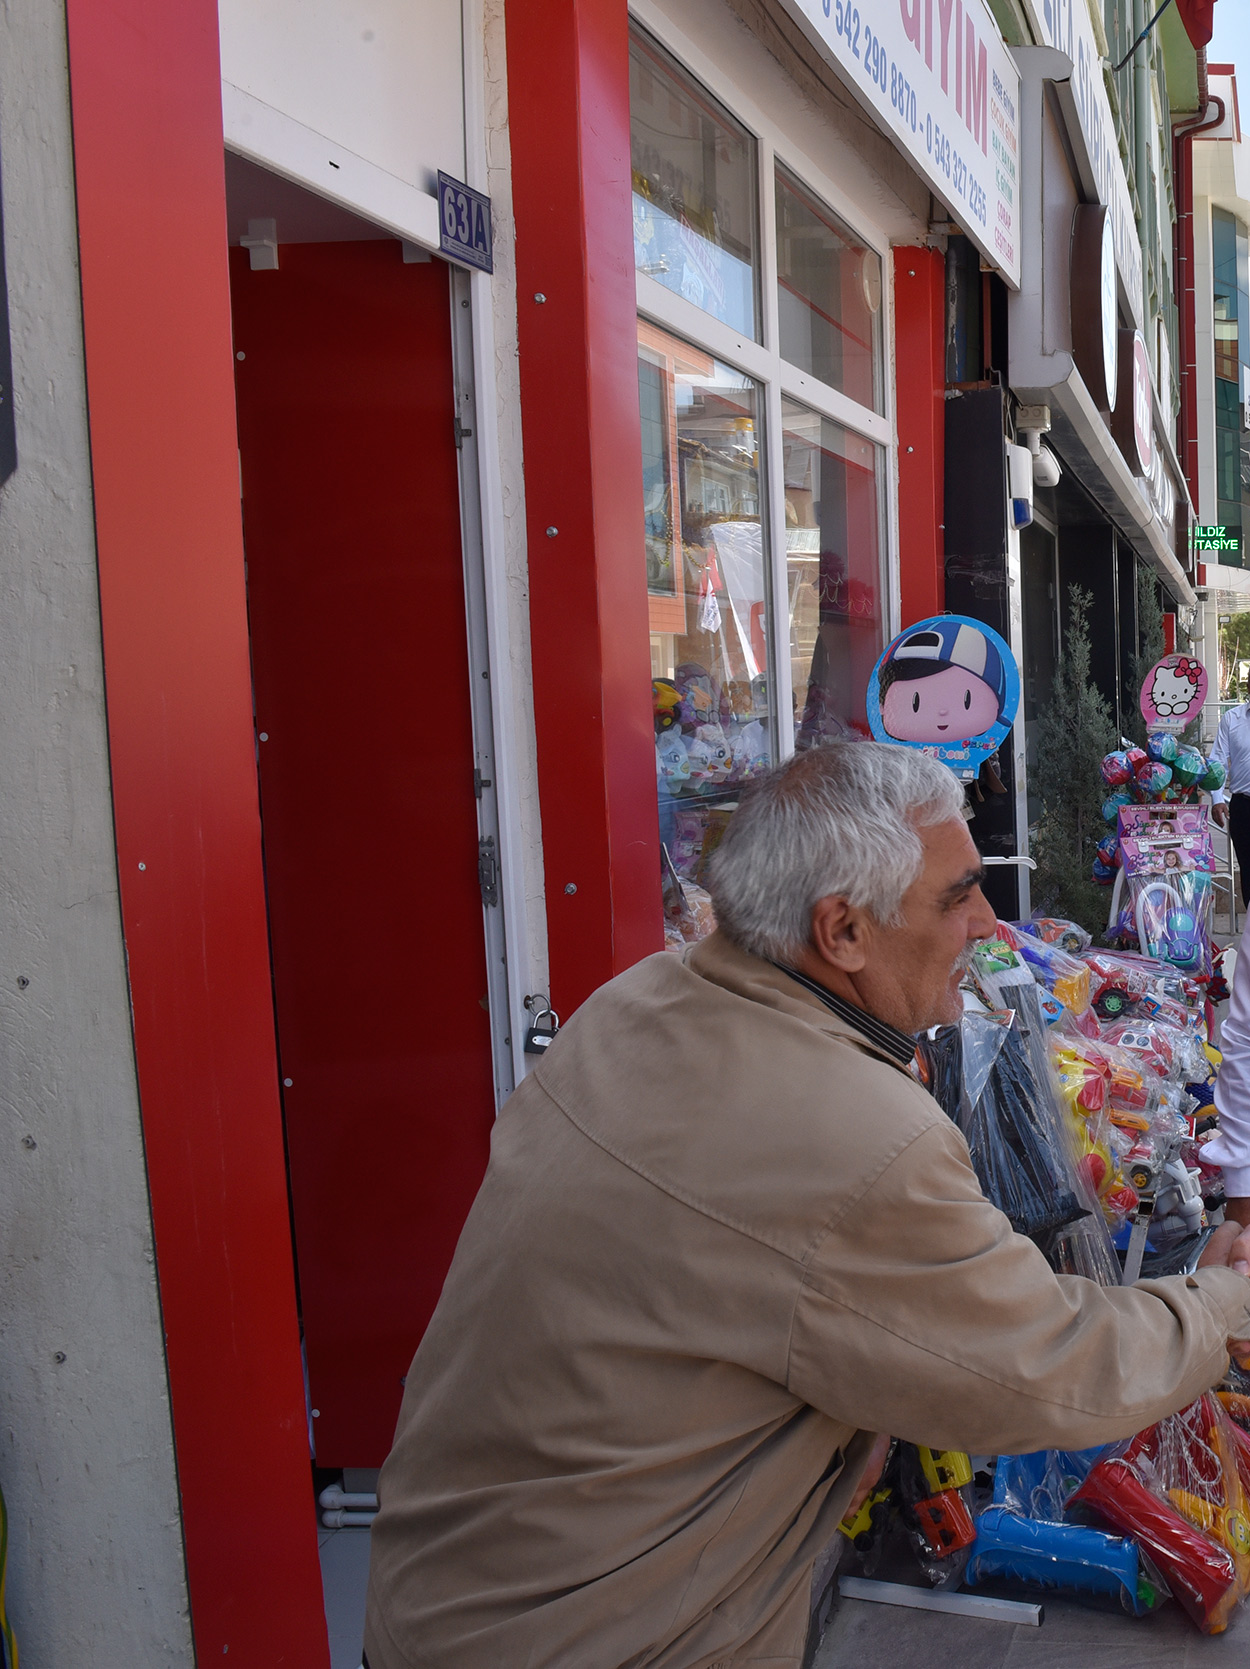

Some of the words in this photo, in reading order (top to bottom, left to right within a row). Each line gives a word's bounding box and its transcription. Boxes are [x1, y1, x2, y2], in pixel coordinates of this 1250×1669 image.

[835, 0, 860, 60] 542
[864, 25, 887, 94] 290
[891, 62, 917, 134] 8870
[926, 112, 932, 154] 0
[935, 124, 951, 179] 543
[953, 150, 967, 200] 327
[969, 173, 987, 228] 2255
[1194, 526, 1226, 537] ILDIZ
